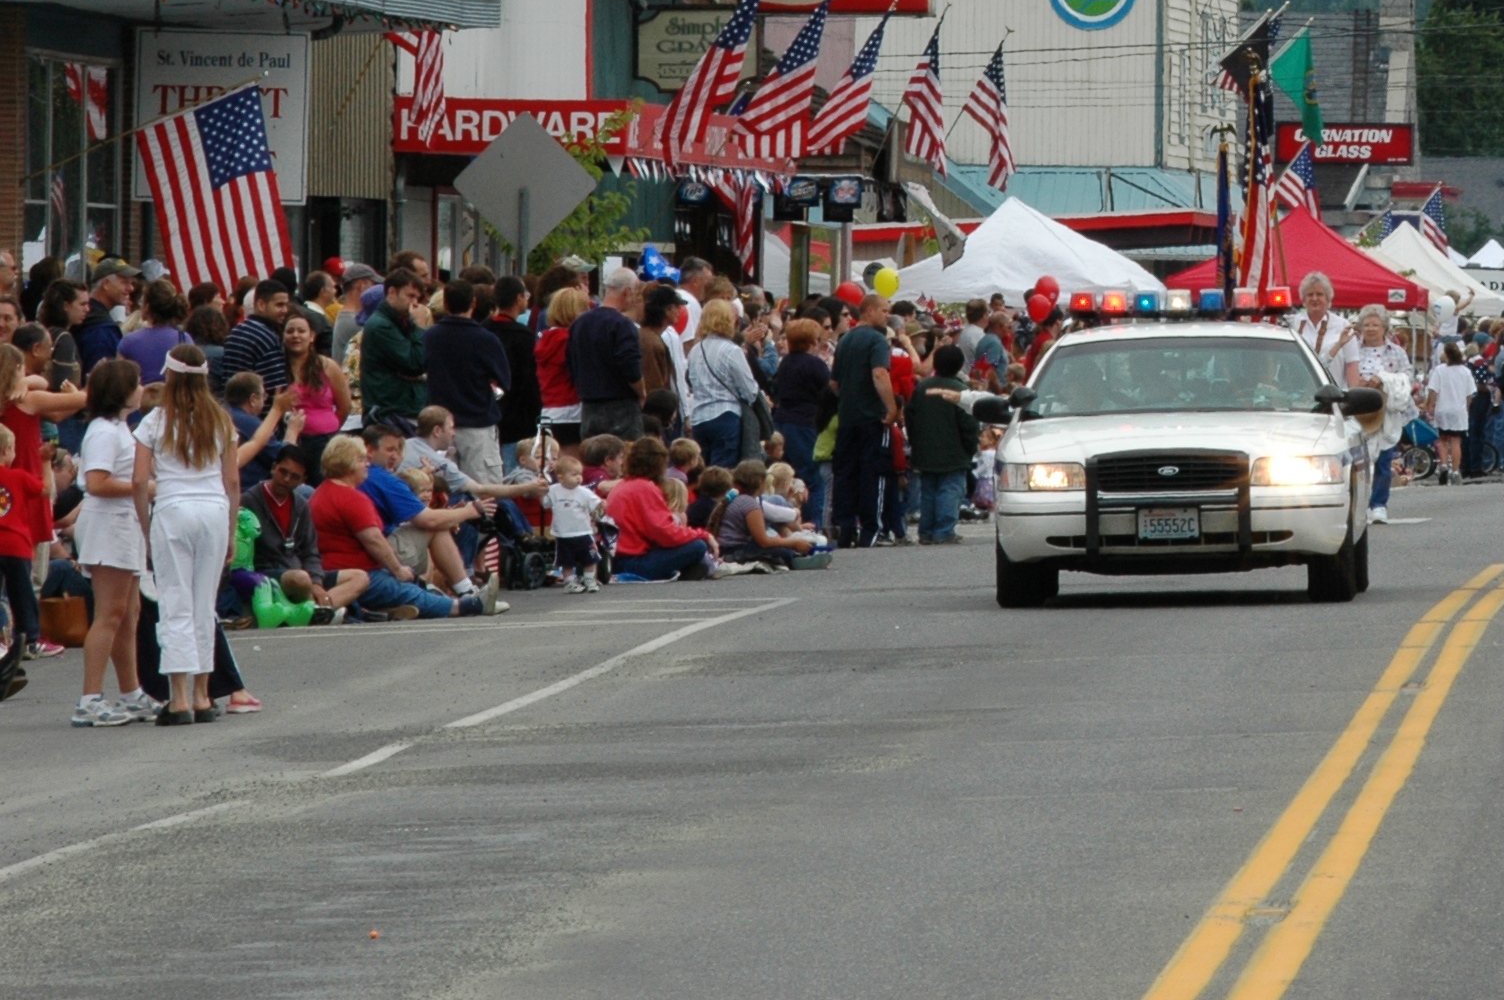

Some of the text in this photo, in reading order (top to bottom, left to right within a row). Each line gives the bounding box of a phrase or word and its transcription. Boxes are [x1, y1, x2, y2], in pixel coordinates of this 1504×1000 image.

[665, 15, 729, 39] Simpl
[157, 51, 291, 69] St. Vincent de Paul
[1294, 128, 1393, 144] CRNATION
[1314, 144, 1373, 159] GLASS
[1149, 517, 1195, 533] 55552C
